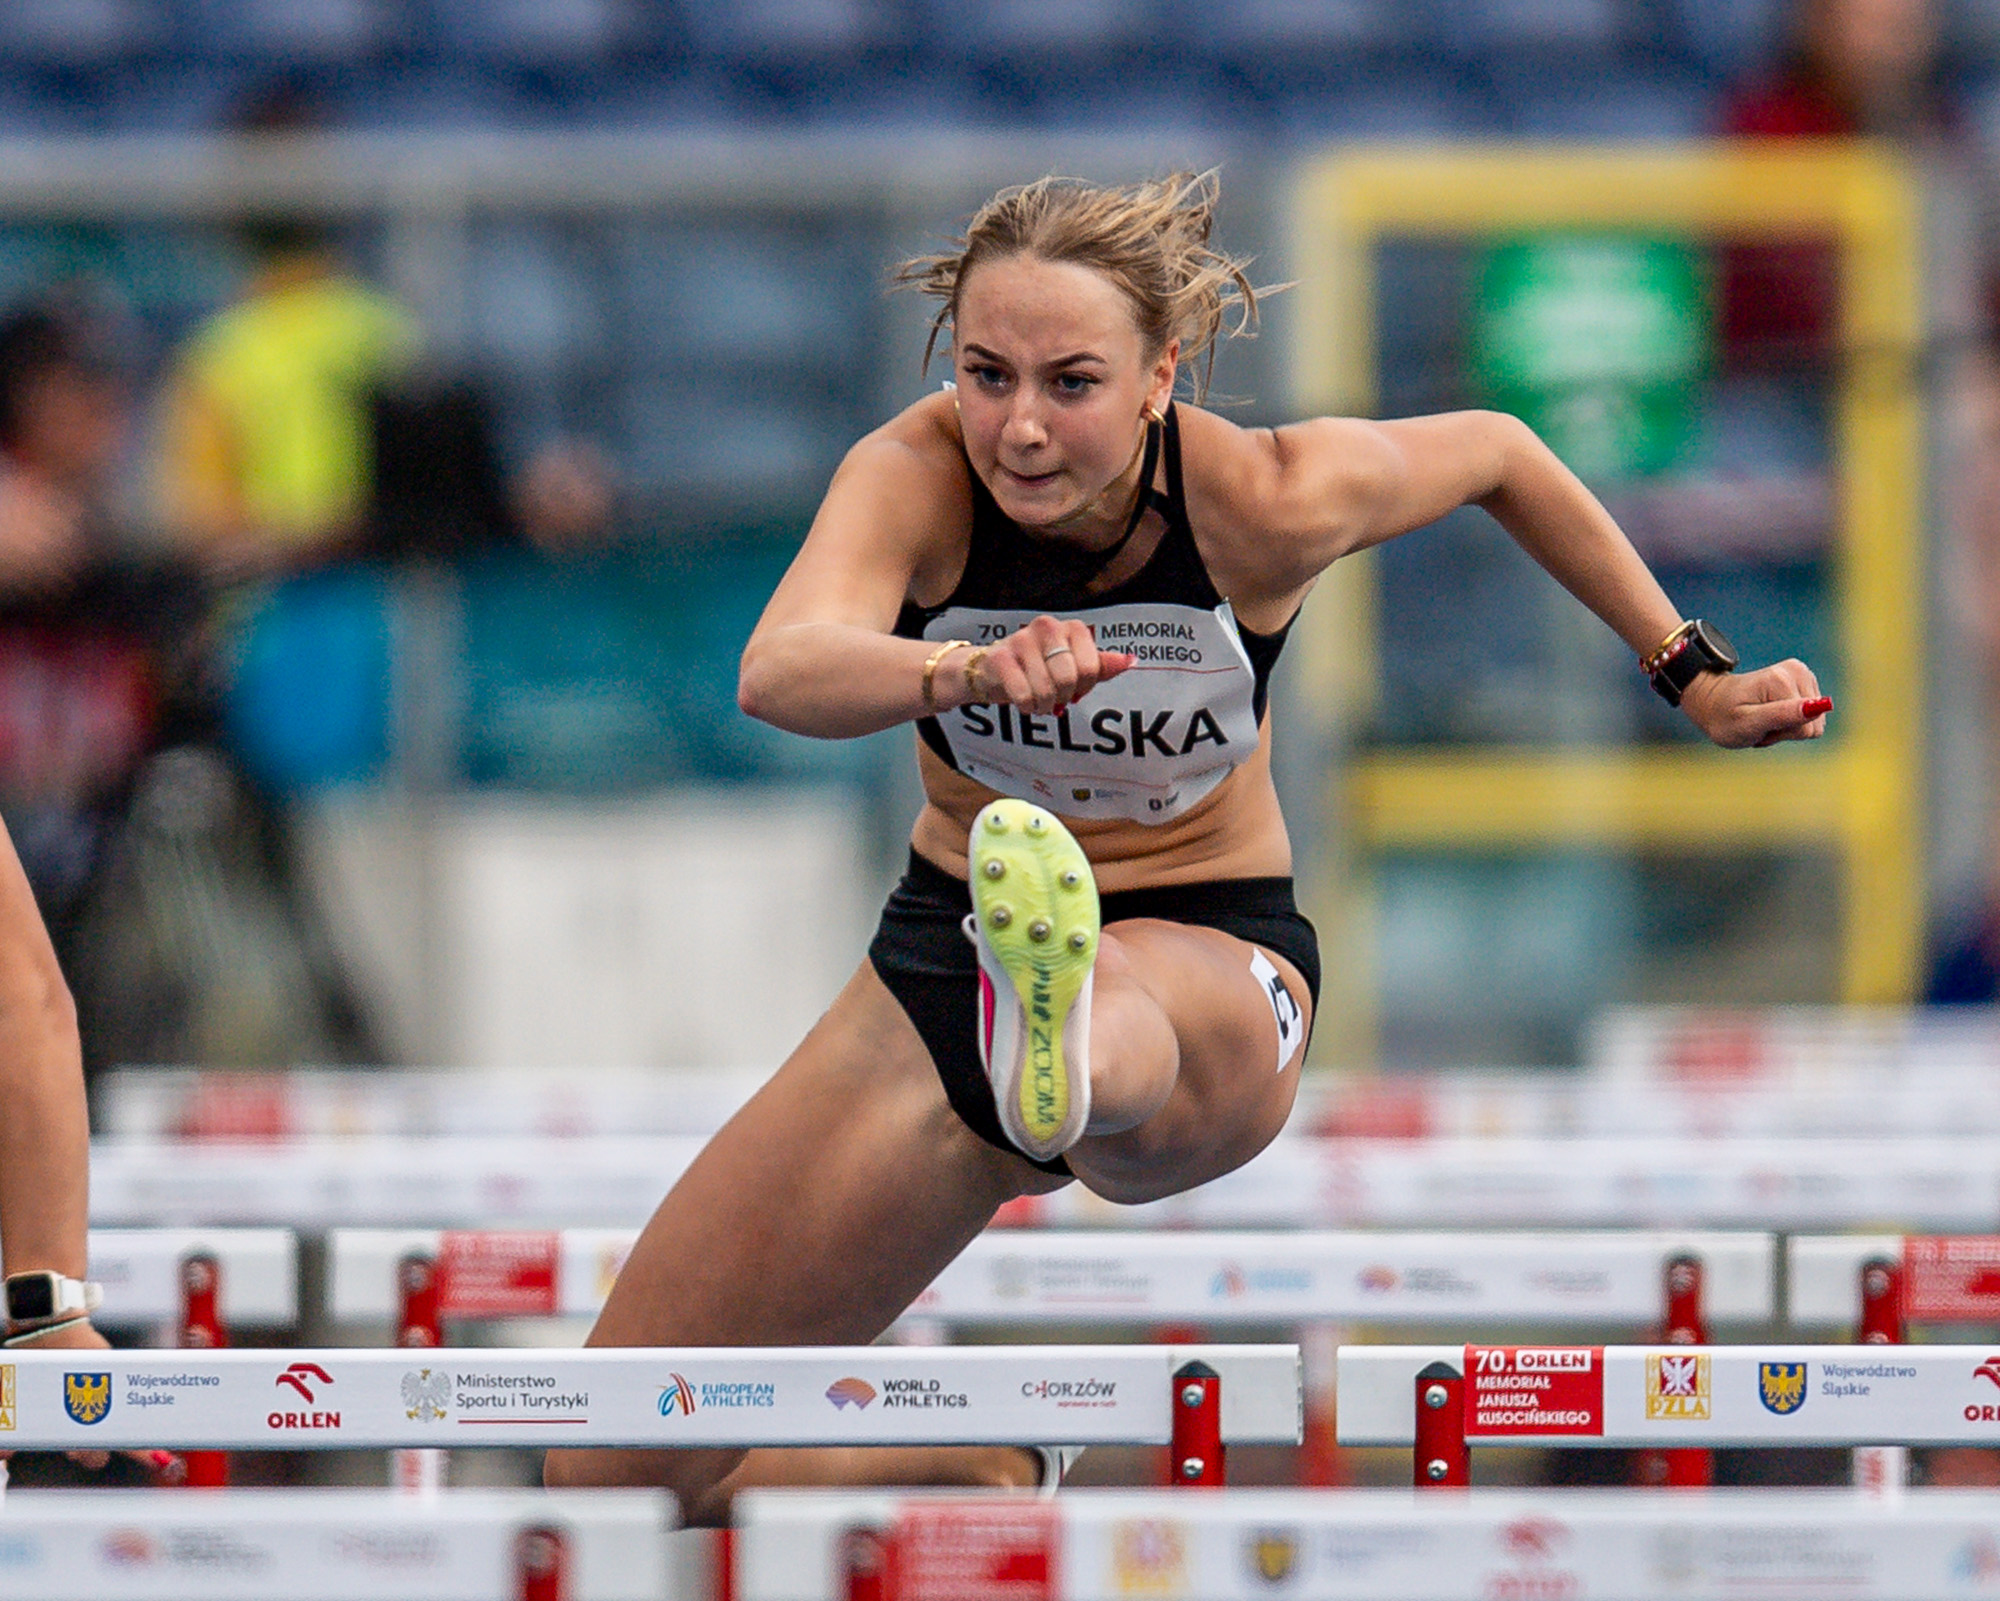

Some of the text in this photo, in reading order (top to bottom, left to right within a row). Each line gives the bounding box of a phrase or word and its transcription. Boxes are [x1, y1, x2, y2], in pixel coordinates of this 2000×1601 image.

[1101, 622, 1195, 640] MEMORIAŁ
[960, 702, 1229, 757] SIELSKA
[1519, 1353, 1586, 1368] ORLEN
[1823, 1365, 1916, 1380] Województwo
[126, 1374, 220, 1390] Województwo
[456, 1374, 556, 1388] Ministerstwo
[883, 1380, 940, 1392] WORLD
[1021, 1378, 1116, 1398] CHORZÓW
[1476, 1376, 1552, 1389] MEMORIAŁ
[702, 1383, 774, 1396] EUROPEAN
[1822, 1382, 1870, 1398] Śląskie
[126, 1391, 174, 1407] Śląskie
[456, 1393, 507, 1411] Sportu
[521, 1392, 589, 1411] Turystyki
[702, 1395, 774, 1407] ATHLETICS
[1476, 1393, 1539, 1407] JANUSZA
[1650, 1396, 1707, 1416] PZLA
[267, 1412, 341, 1428] ORLEN
[1477, 1410, 1591, 1426] KUSOCIŃSKIEGO
